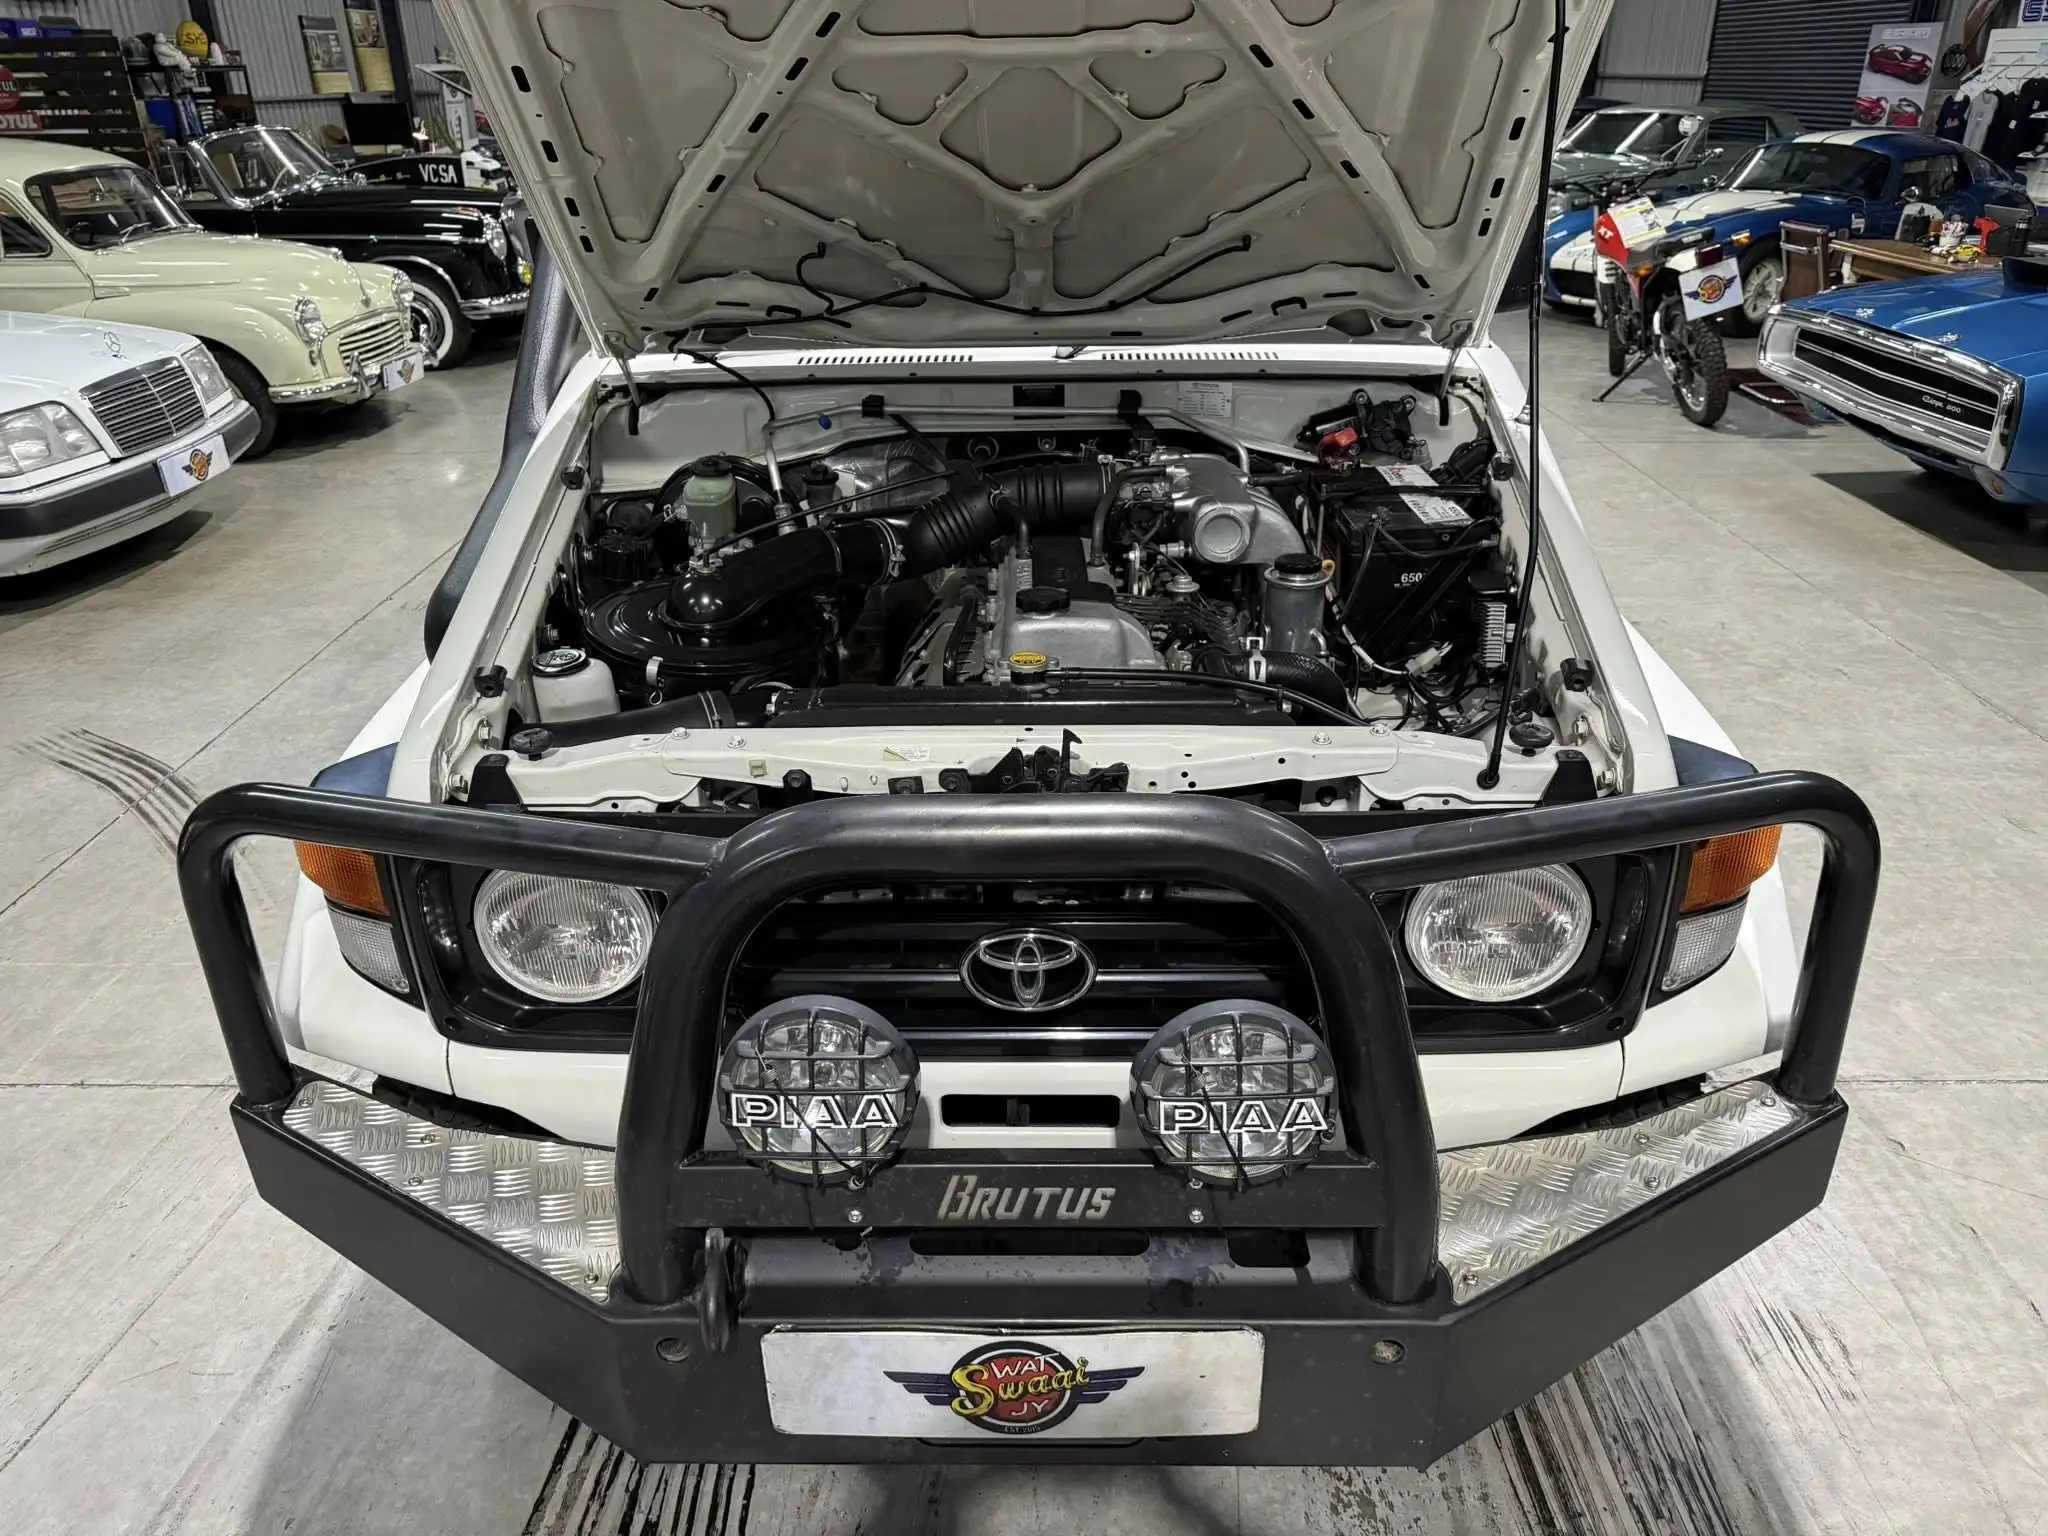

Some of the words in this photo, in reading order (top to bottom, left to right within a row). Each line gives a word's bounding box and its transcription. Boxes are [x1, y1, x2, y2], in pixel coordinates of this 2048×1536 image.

[0, 81, 17, 91] UL
[419, 164, 458, 184] VCSA
[1401, 572, 1422, 583] 650
[731, 1093, 899, 1129] PIAA
[1160, 1098, 1328, 1134] PIAA
[937, 1175, 1116, 1220] BRUTUS
[990, 1353, 1060, 1379] WAT
[951, 1356, 1090, 1416] Swaai
[1011, 1399, 1051, 1416] JY
